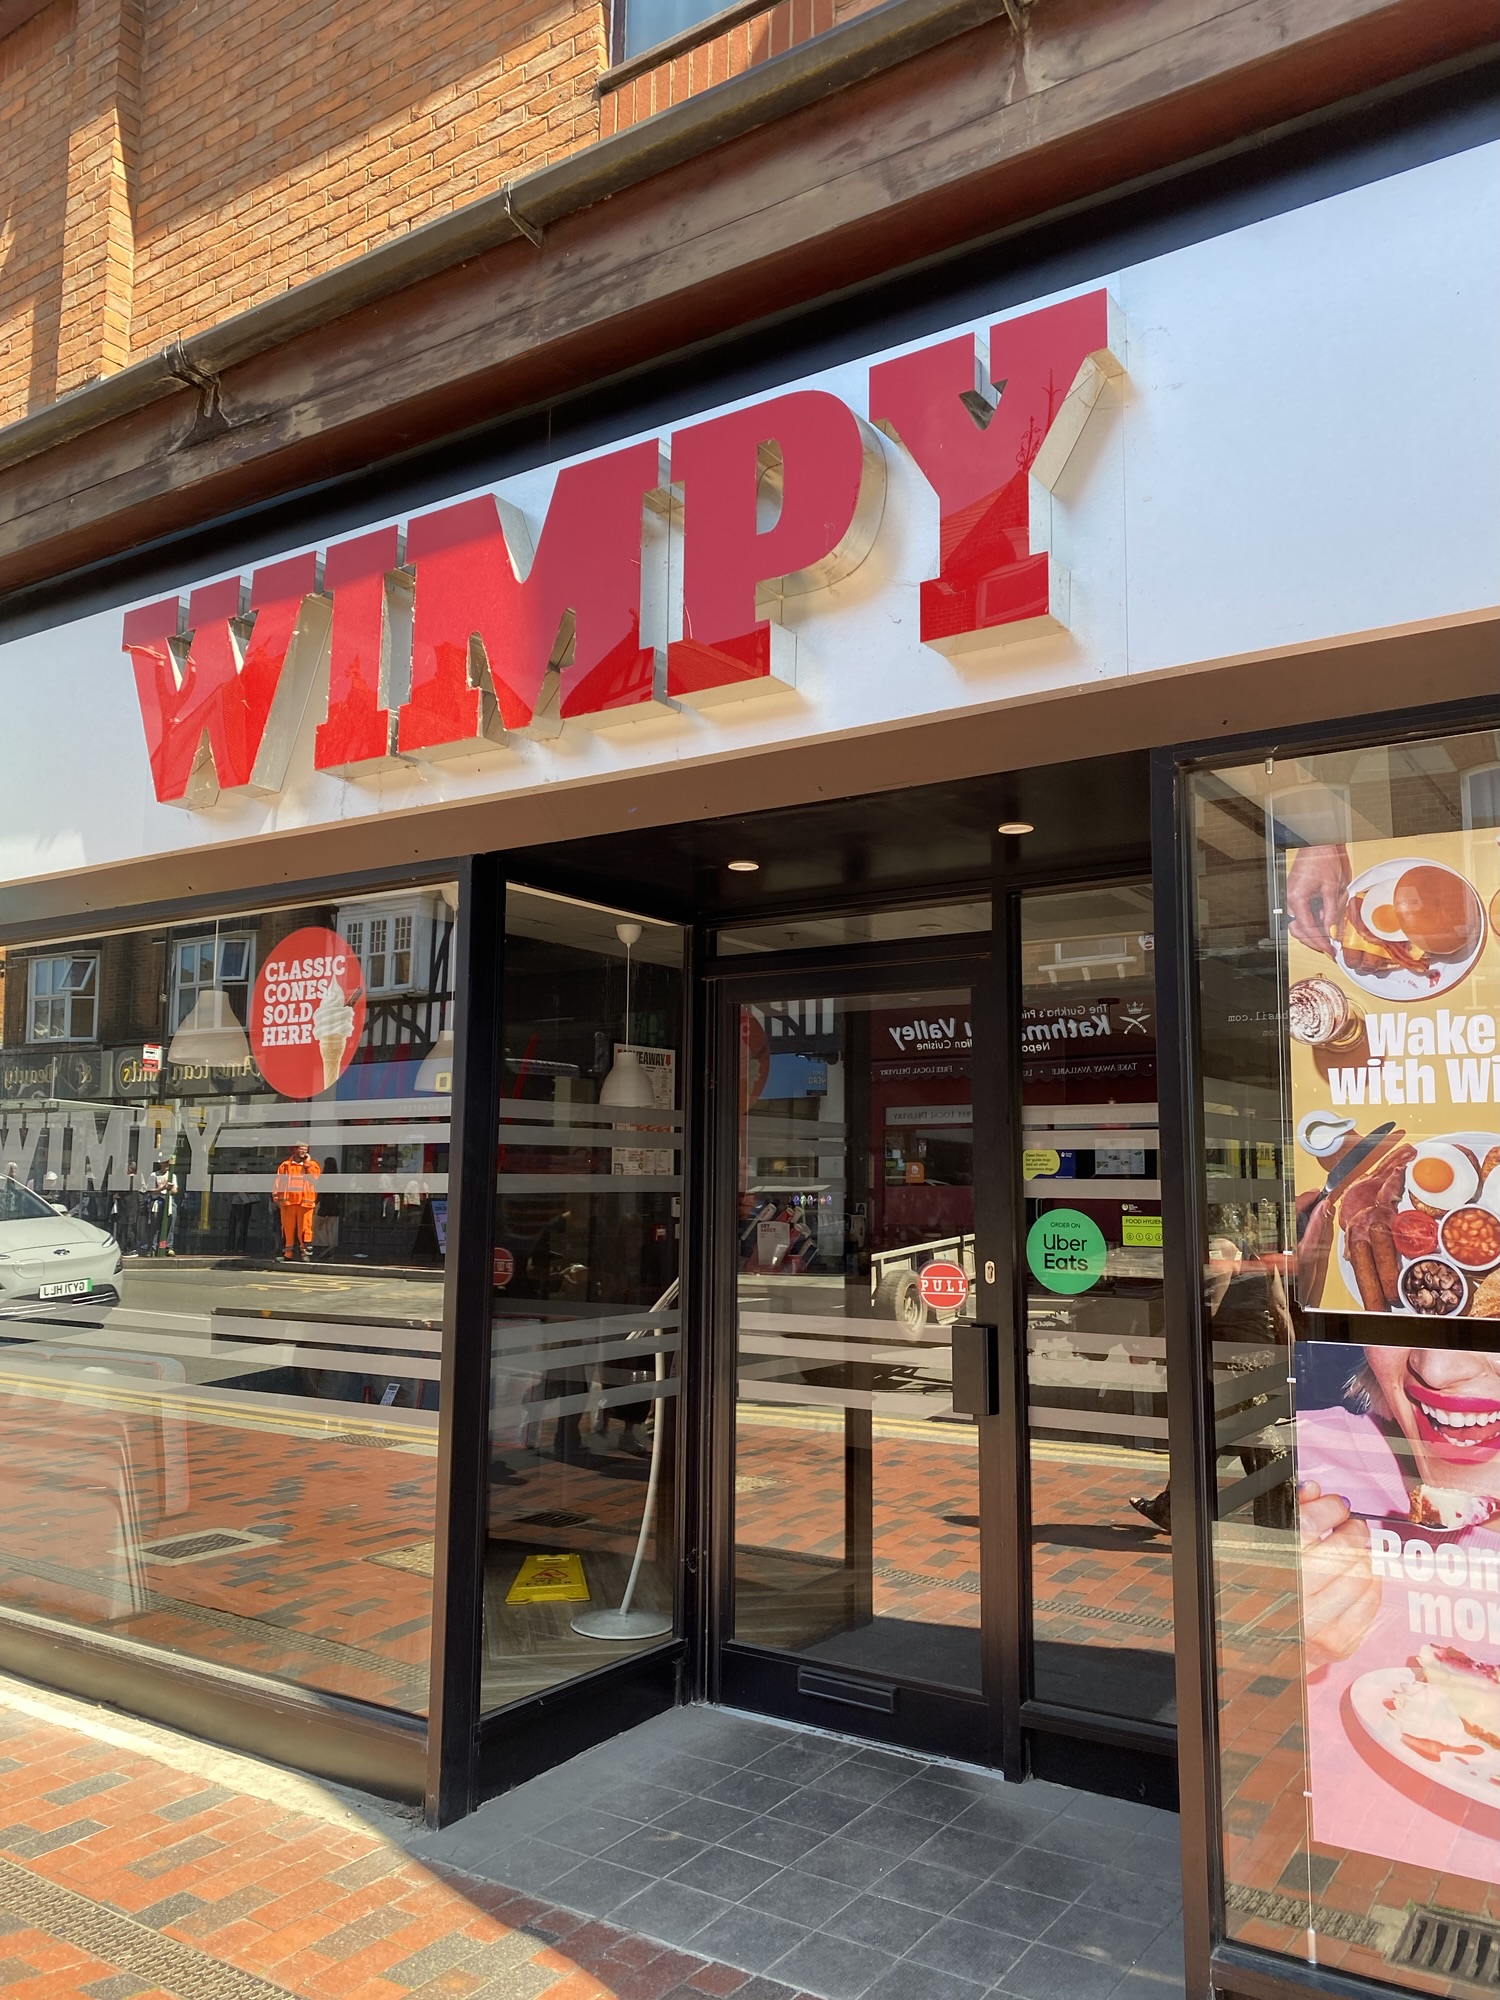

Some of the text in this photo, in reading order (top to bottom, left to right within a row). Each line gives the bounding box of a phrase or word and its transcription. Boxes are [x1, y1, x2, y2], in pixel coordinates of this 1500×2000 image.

[122, 289, 1112, 803] WIMPY
[265, 955, 346, 982] CLASSIC
[264, 979, 328, 1003] CONES
[263, 1002, 313, 1025] SOLD
[262, 1024, 312, 1046] HERE
[1365, 1009, 1496, 1057] Wake
[1328, 1058, 1436, 1105] with
[1043, 1234, 1088, 1252] Uber
[1044, 1253, 1088, 1271] Eats
[920, 1280, 966, 1292] PULL
